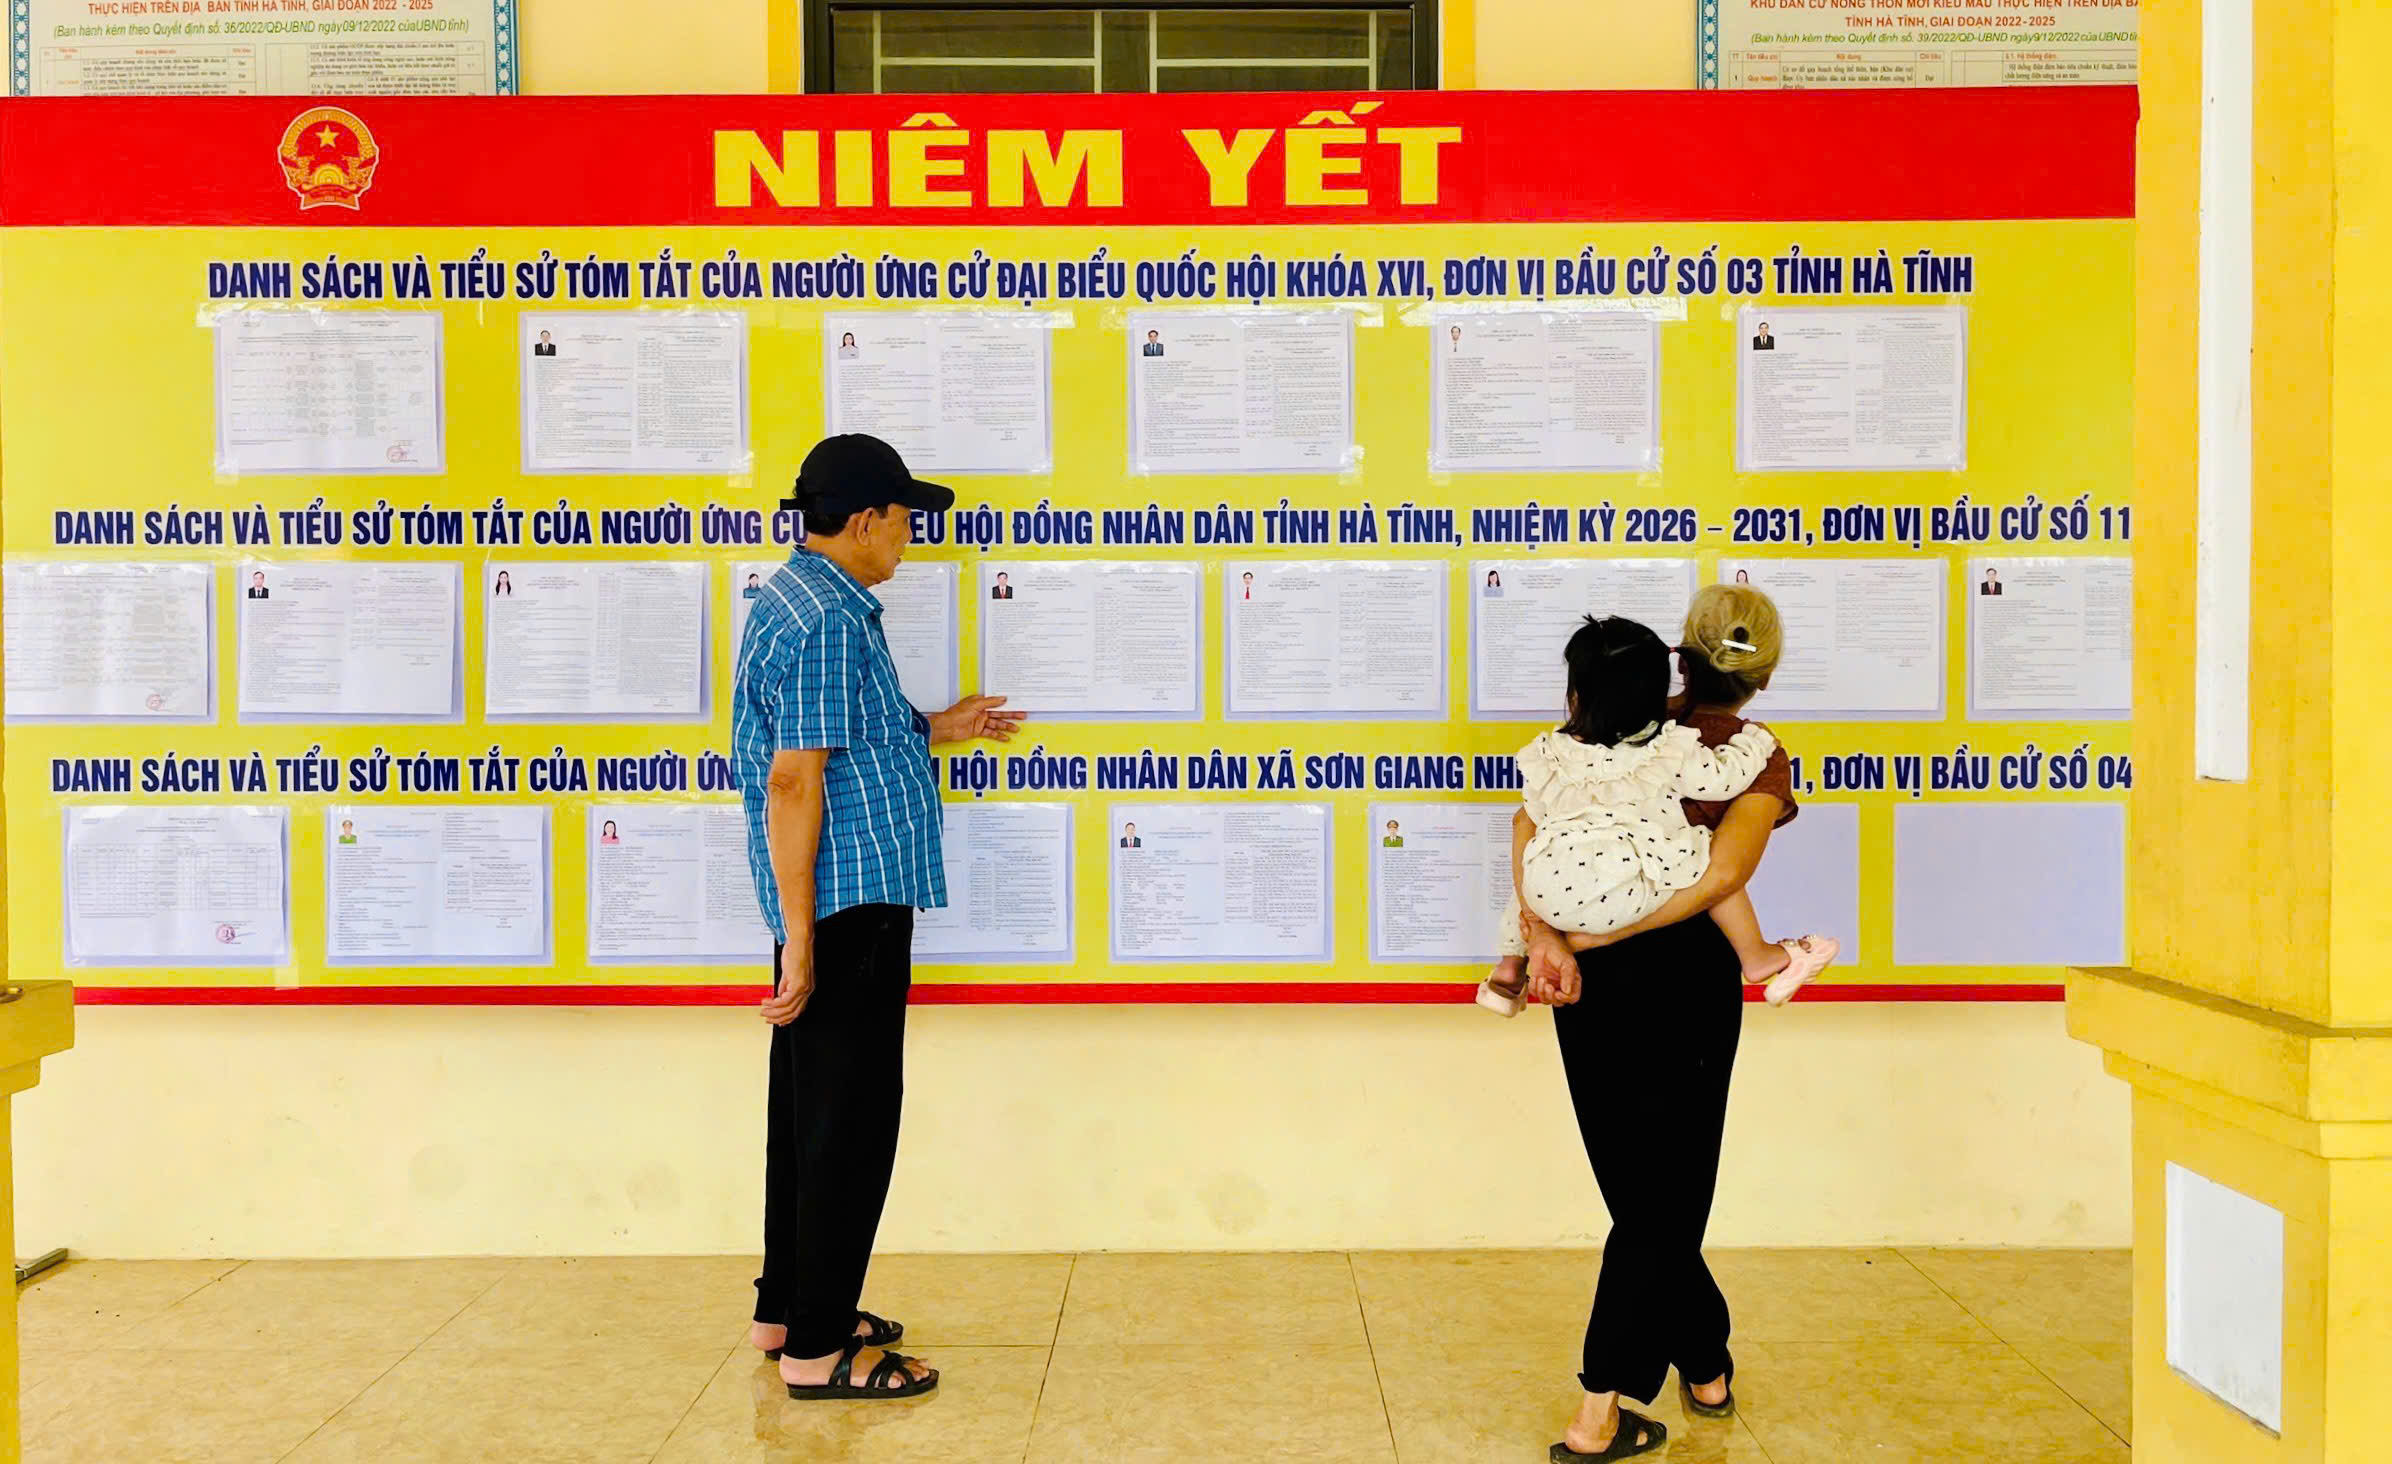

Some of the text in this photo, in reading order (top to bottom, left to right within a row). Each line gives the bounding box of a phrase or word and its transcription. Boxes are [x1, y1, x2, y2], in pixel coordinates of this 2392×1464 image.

[312, 0, 334, 11] GIAI
[373, 0, 397, 10] 2022
[409, 0, 433, 10] 2025
[1876, 14, 1893, 27] HÀ
[1930, 16, 1953, 27] GIAI
[1957, 16, 1993, 29] ĐOẠN
[714, 102, 1462, 207] NIÊM YẾT
[209, 244, 1972, 307] DANH SÁCH VÀ TIỂU SỬ TÓM TẮT CỦA NGƯỜI ỨNG CỬ ĐẠI BIỂU QUỐC HỘI KHÓA XVI, ĐƠN VỊ BẦU CỬ SỐ 03 TỈNH HÀ TĨNH
[55, 511, 134, 545] DANH
[144, 504, 223, 545] SÁCH
[232, 504, 271, 545] VÀ
[279, 497, 342, 545] TIỂU
[352, 499, 394, 545] SỬ
[399, 503, 463, 545] TÓM
[472, 498, 524, 545] TẮT
[533, 499, 592, 545] CỦA
[601, 502, 691, 545] NGƯỜI
[701, 503, 762, 545] ỨNG
[954, 503, 1003, 552] HỘI
[1012, 499, 1093, 545] ĐỒNG
[1103, 503, 1184, 544] NHÂN
[1194, 503, 1254, 544] DÂN
[1262, 498, 1329, 544] TỈNH
[1339, 502, 1378, 543] HÀ
[1386, 503, 1462, 547] TĨNH,
[1472, 501, 1568, 550] NHIỆM
[1579, 501, 1616, 542] KỲ
[1625, 508, 1697, 543] 2026
[1733, 508, 1813, 546] 2031,
[1822, 504, 1884, 542] ĐƠN
[1894, 507, 1921, 549] VỊ
[1931, 495, 1990, 541] BẦU
[2000, 495, 2043, 541] CỬ
[2049, 494, 2089, 541] SỐ
[2099, 506, 2130, 540] 11
[52, 759, 131, 792] DANH
[141, 751, 220, 793] SÁCH
[229, 751, 267, 792] VÀ
[275, 744, 339, 792] TIỂU
[349, 747, 391, 793] SỬ
[396, 751, 459, 792] TÓM
[468, 745, 520, 792] TẮT
[529, 746, 588, 792] CỦA
[597, 749, 687, 792] NGƯỜI
[697, 750, 737, 791] ỨN
[950, 749, 998, 798] HỘI
[1007, 745, 1087, 790] ĐỒNG
[1097, 749, 1178, 790] NHÂN
[1188, 748, 1247, 789] DÂN
[1257, 749, 1296, 789] XÃ
[1305, 752, 1365, 790] SƠN
[1374, 755, 1464, 790] GIANG
[1822, 752, 1884, 790] ĐƠN
[1894, 756, 1921, 798] VỊ
[1931, 744, 1990, 790] BẦU
[2000, 744, 2043, 790] CỬ
[2049, 743, 2089, 789] SỐ
[2098, 755, 2132, 789] 04
